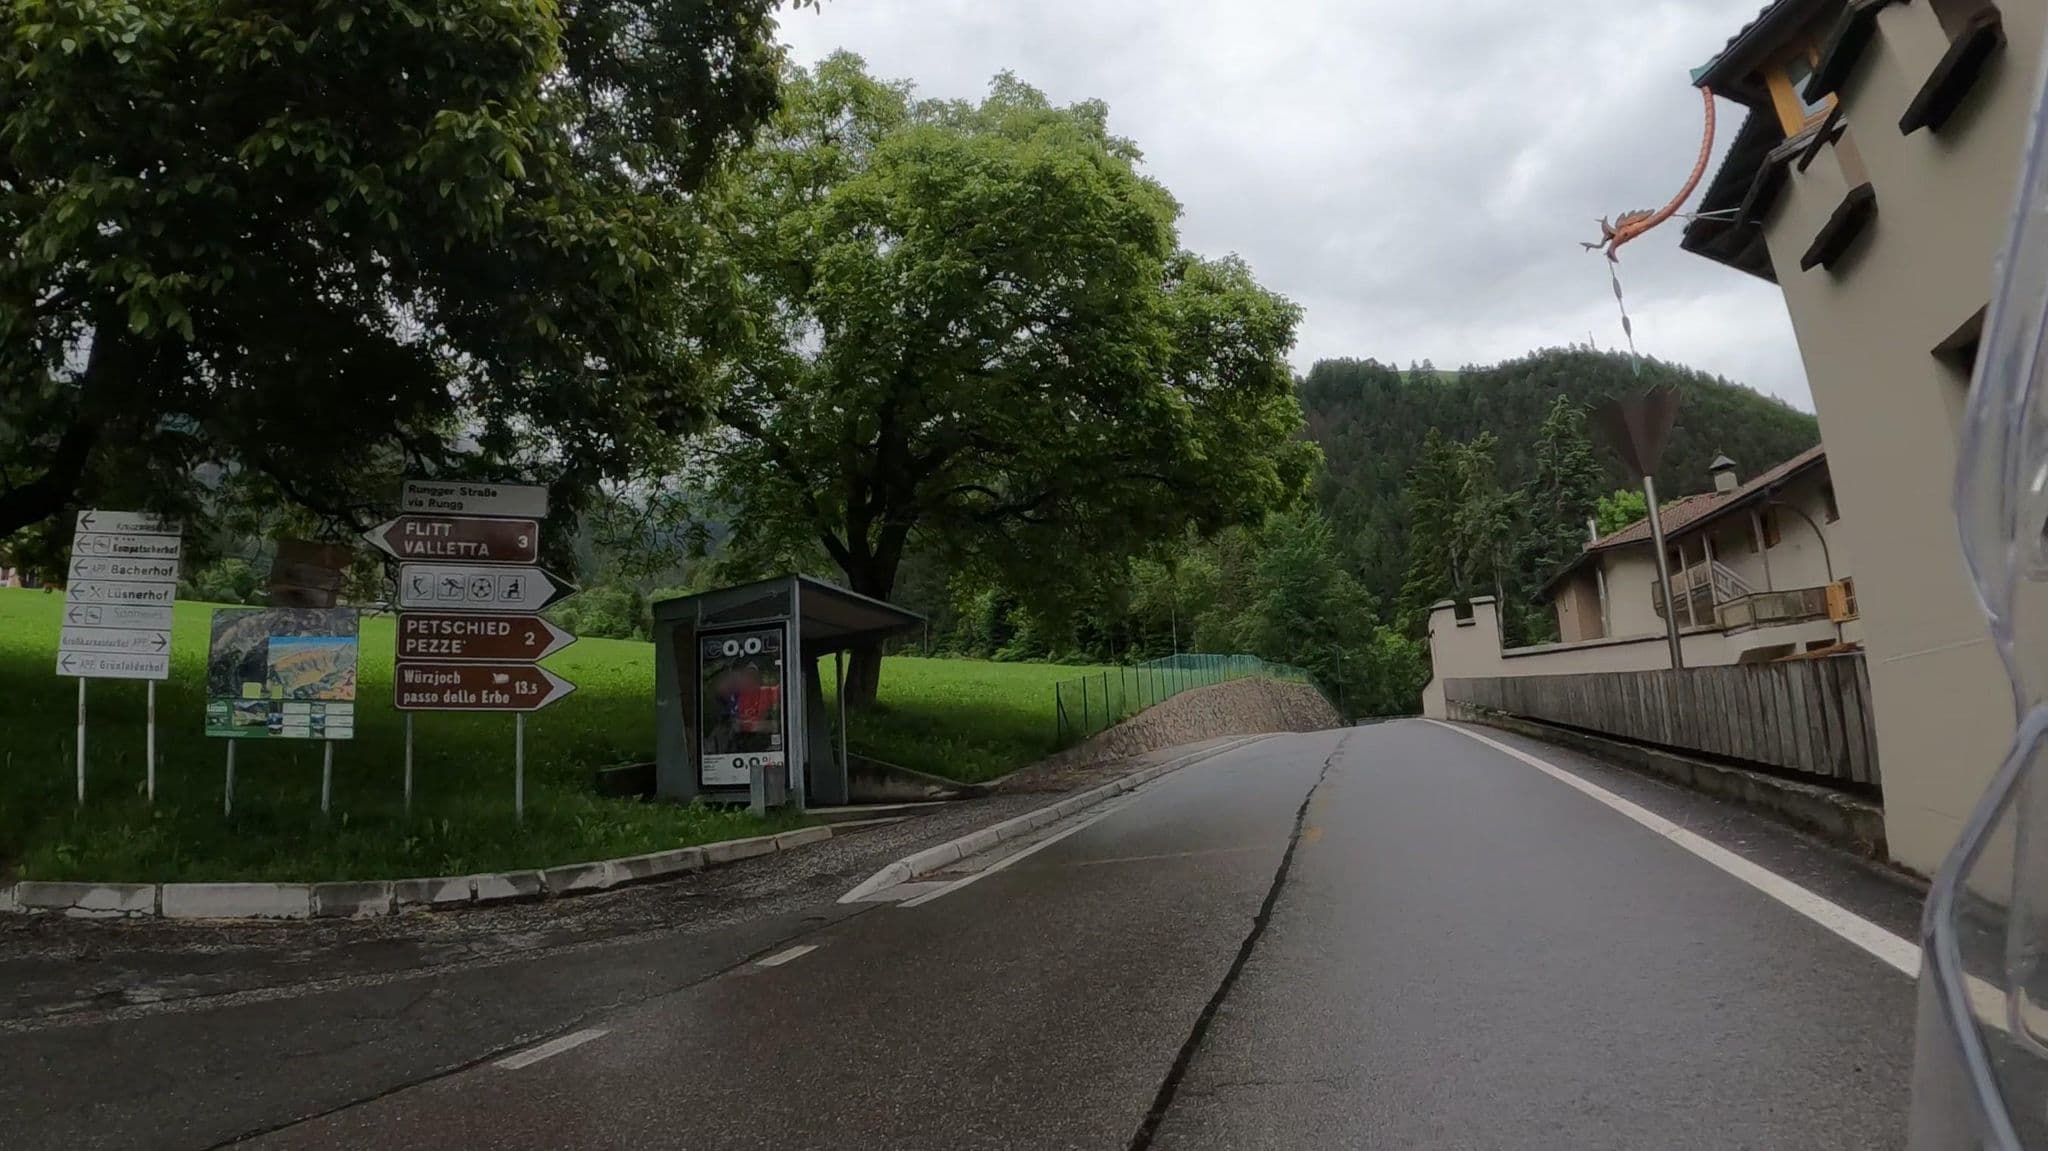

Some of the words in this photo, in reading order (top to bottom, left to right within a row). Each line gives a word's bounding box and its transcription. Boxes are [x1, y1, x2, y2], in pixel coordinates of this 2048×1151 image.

[408, 485, 455, 497] Rungger
[459, 487, 498, 498] Straße
[408, 499, 424, 508] via
[428, 500, 464, 511] Rungg
[405, 522, 452, 537] FLITT
[404, 540, 490, 557] VALLETTA
[517, 535, 529, 549] 3
[110, 564, 174, 577] Bacherhof
[406, 619, 511, 635] PETSCHIED
[524, 632, 536, 646] 2
[403, 669, 461, 685] Würzjoch
[403, 691, 439, 705] passo
[443, 690, 476, 703] delle
[481, 690, 510, 704] Erbe
